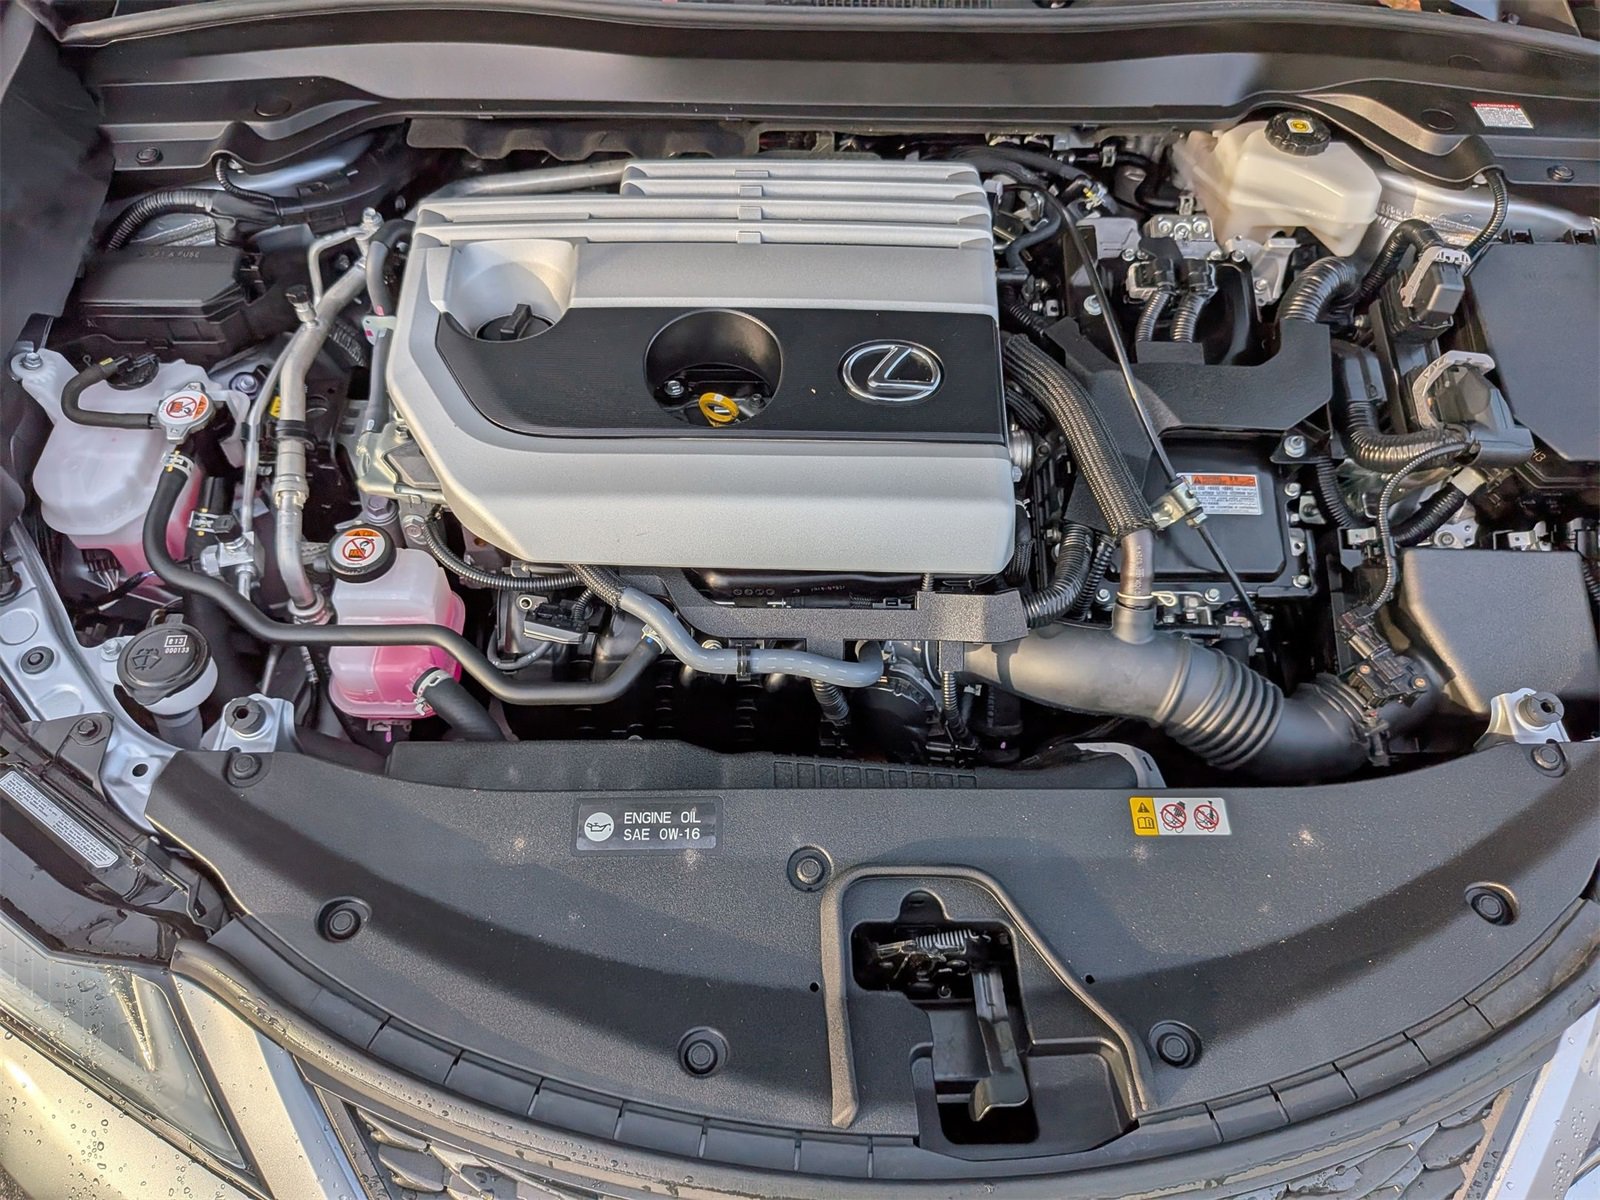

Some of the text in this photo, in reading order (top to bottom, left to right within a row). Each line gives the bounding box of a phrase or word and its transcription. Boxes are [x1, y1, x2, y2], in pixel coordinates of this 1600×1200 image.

[624, 811, 702, 824] ENGINE OIL
[623, 827, 701, 841] SAE 0W-16
